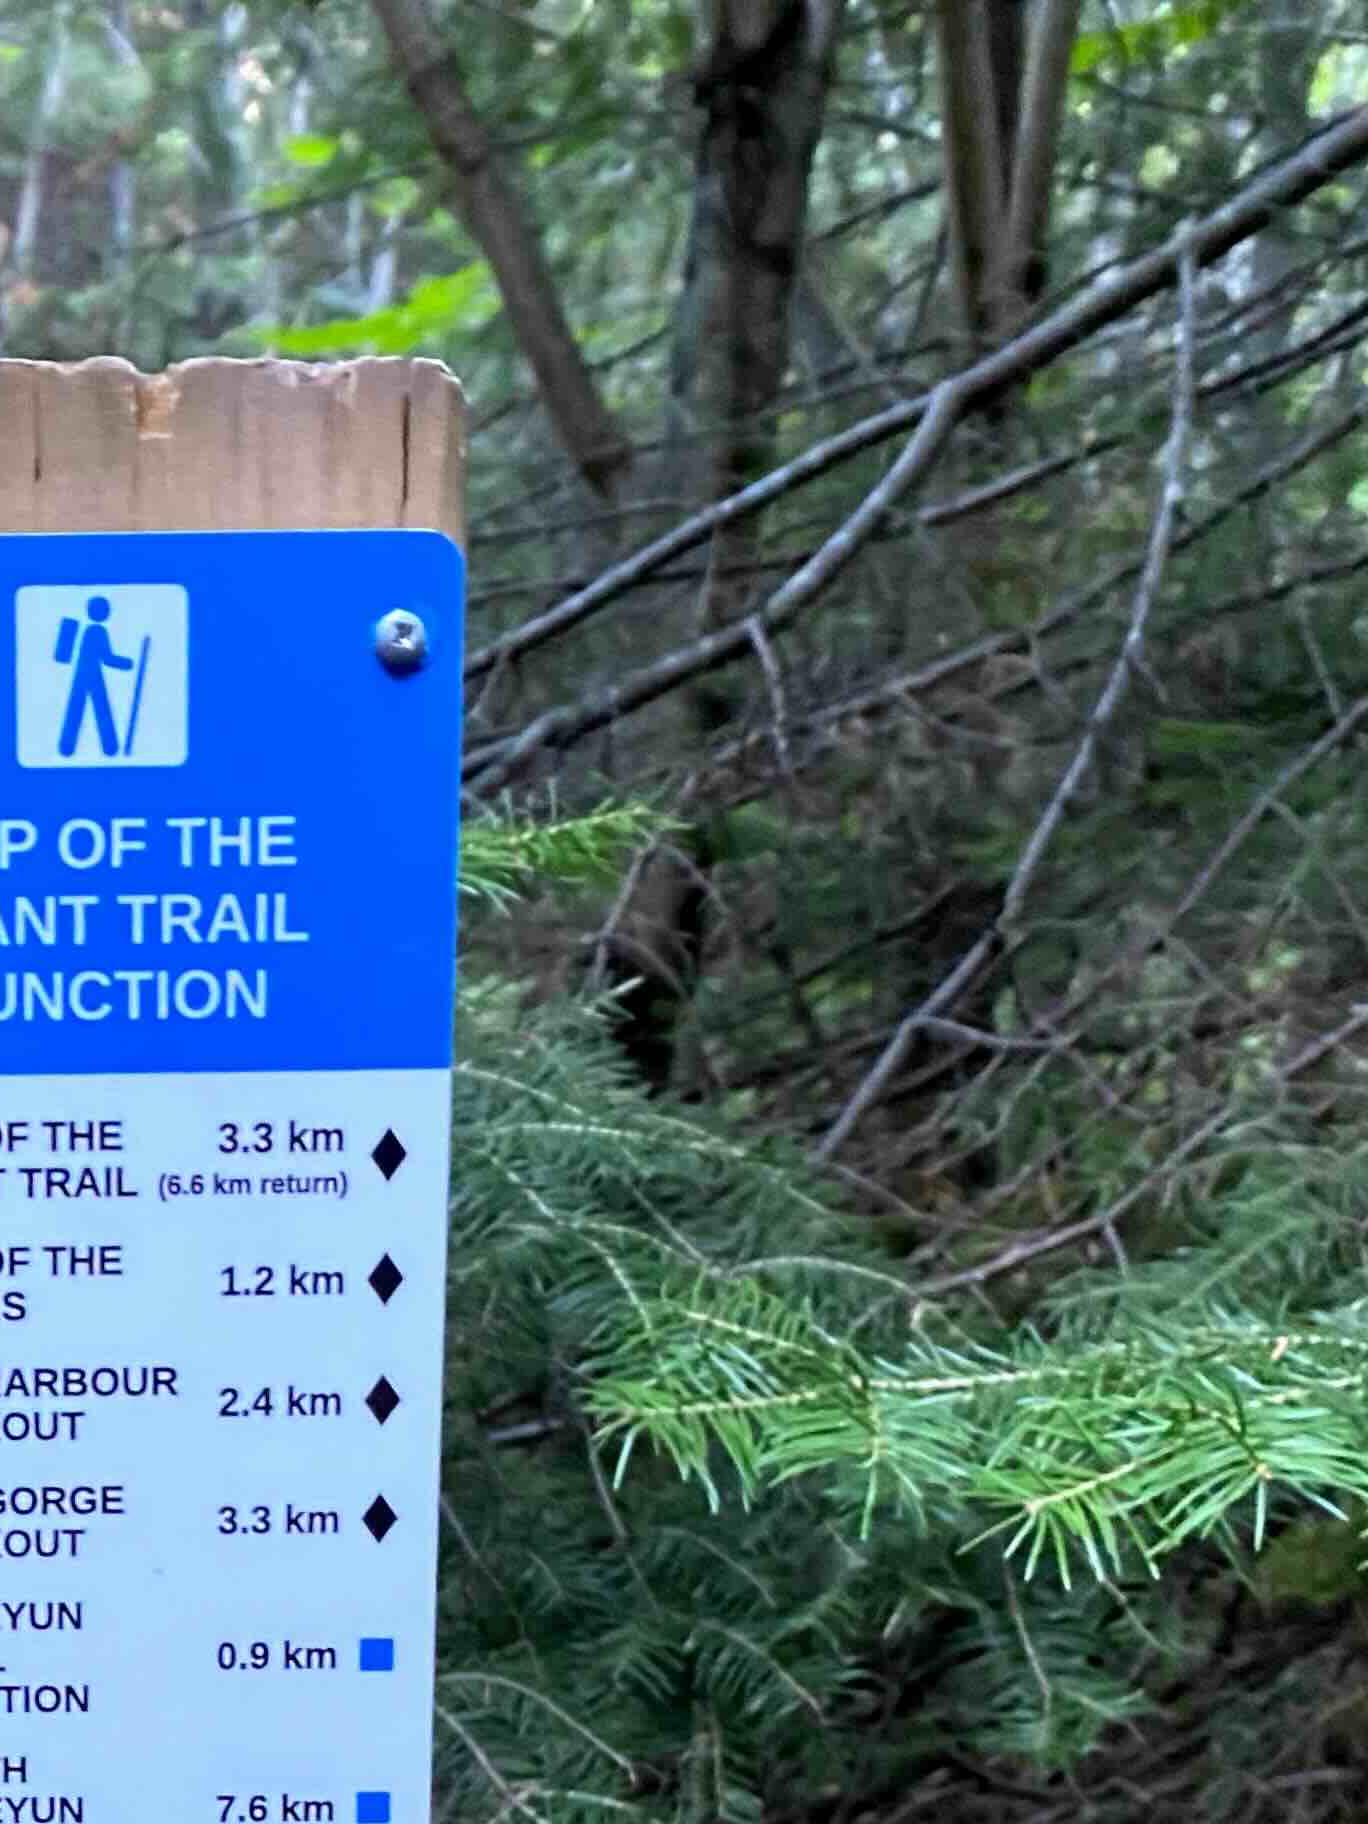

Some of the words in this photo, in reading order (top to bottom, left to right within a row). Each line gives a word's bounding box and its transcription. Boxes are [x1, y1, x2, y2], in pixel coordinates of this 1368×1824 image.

[60, 820, 144, 867] OF
[168, 817, 296, 866] THE
[119, 895, 306, 943] TRAIL
[42, 1121, 123, 1152] THE
[219, 1122, 273, 1153] 3.3
[288, 1120, 344, 1152] km
[18, 1167, 138, 1198] TRAIL
[159, 1173, 205, 1202] (6.6
[213, 1172, 251, 1195] km
[260, 1171, 348, 1199] return)
[43, 1246, 123, 1276] THE
[221, 1265, 275, 1296] 1.2
[289, 1263, 343, 1295] km
[219, 1386, 273, 1417] 2.4
[287, 1385, 341, 1416] km
[219, 1505, 271, 1535] 3.3
[286, 1503, 338, 1533] km
[218, 1642, 269, 1670] 0.9
[284, 1640, 336, 1669] km
[216, 1795, 267, 1823] 7.6
[282, 1794, 333, 1822] km
